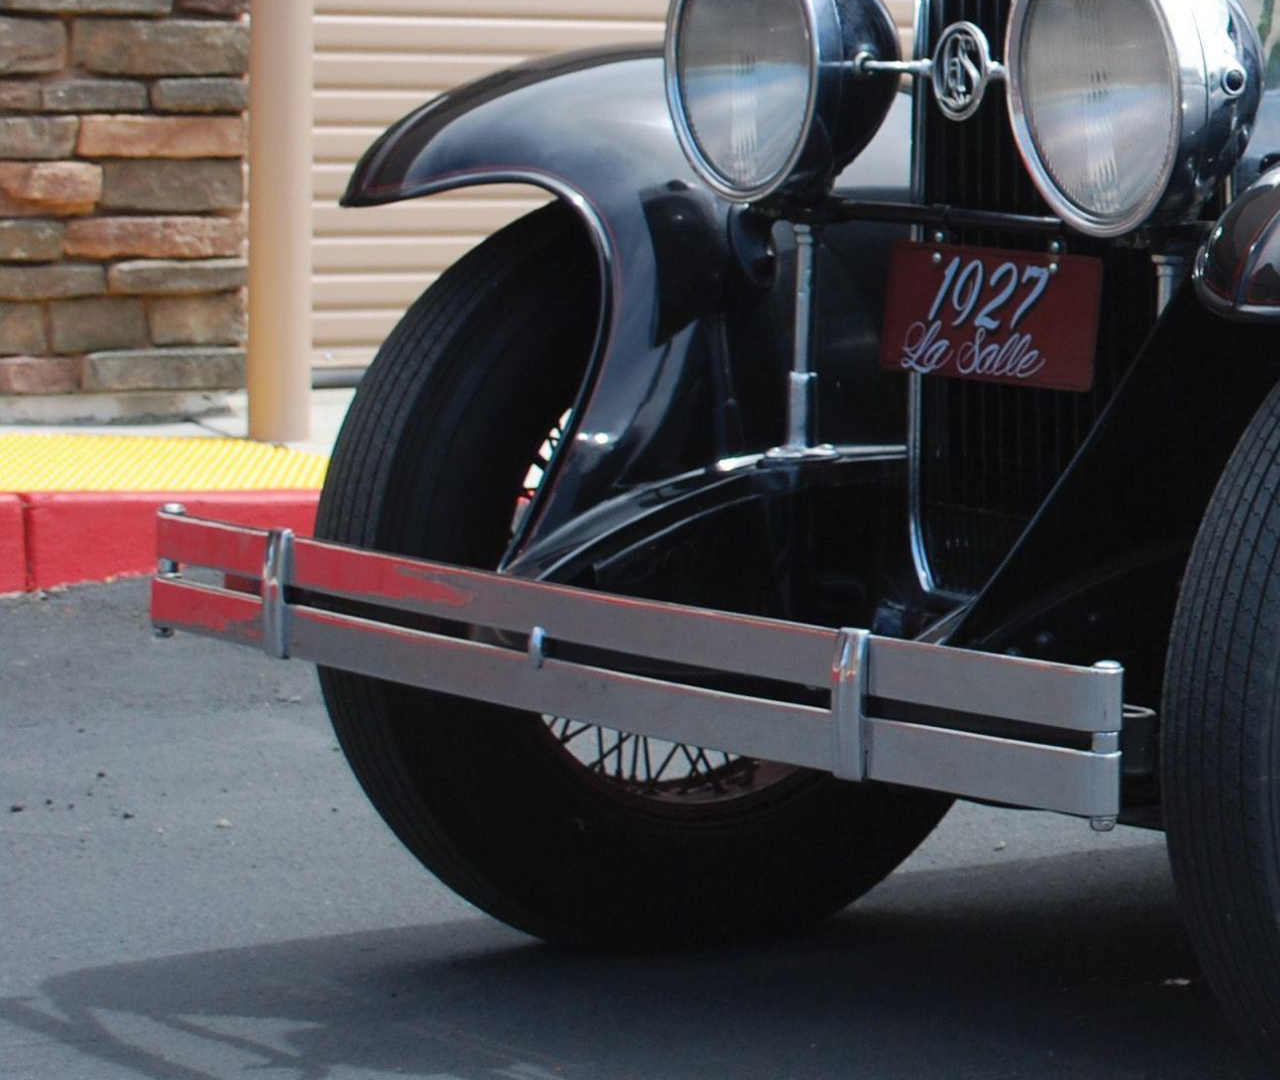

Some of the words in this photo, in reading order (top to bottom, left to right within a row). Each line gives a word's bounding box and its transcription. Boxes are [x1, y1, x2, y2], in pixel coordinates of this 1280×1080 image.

[928, 256, 1050, 330] 1927
[901, 320, 954, 374] La
[957, 327, 1046, 378] Salle
